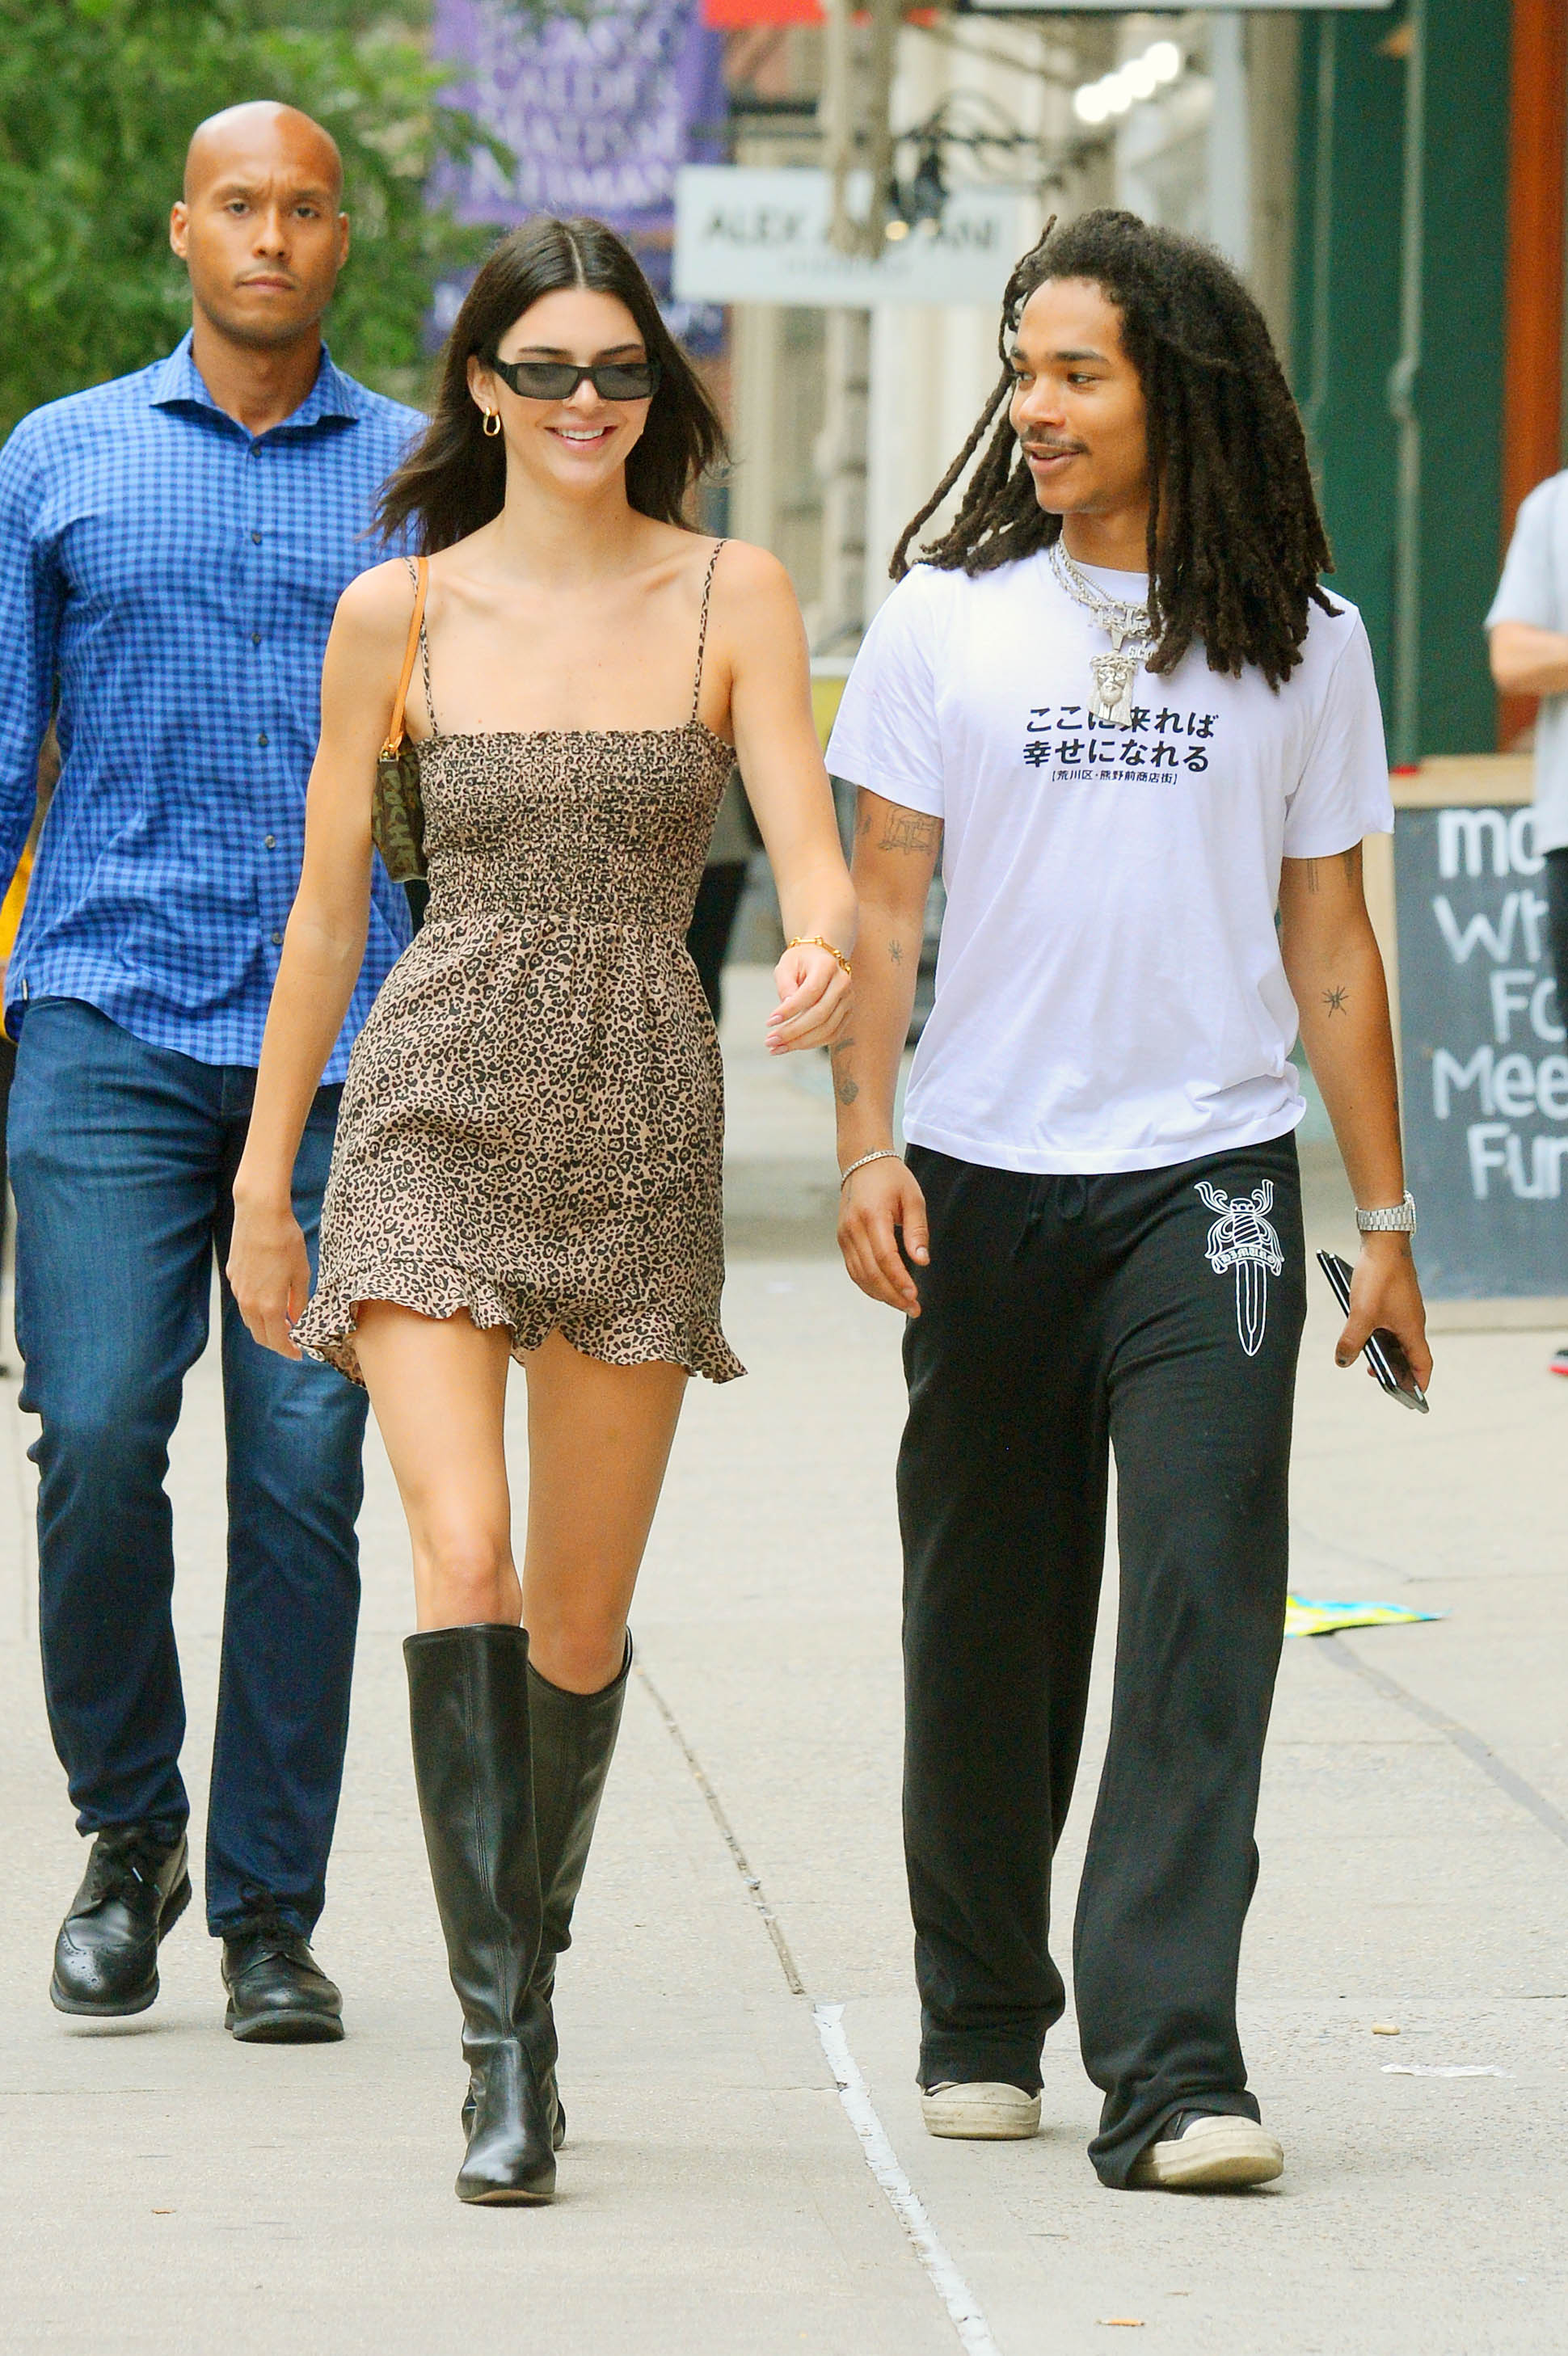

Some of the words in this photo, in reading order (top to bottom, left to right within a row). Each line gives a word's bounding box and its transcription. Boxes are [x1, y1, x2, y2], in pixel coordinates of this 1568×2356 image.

[1023, 738, 1209, 772] 幸せになれる
[1432, 1045, 1567, 1120] Mee
